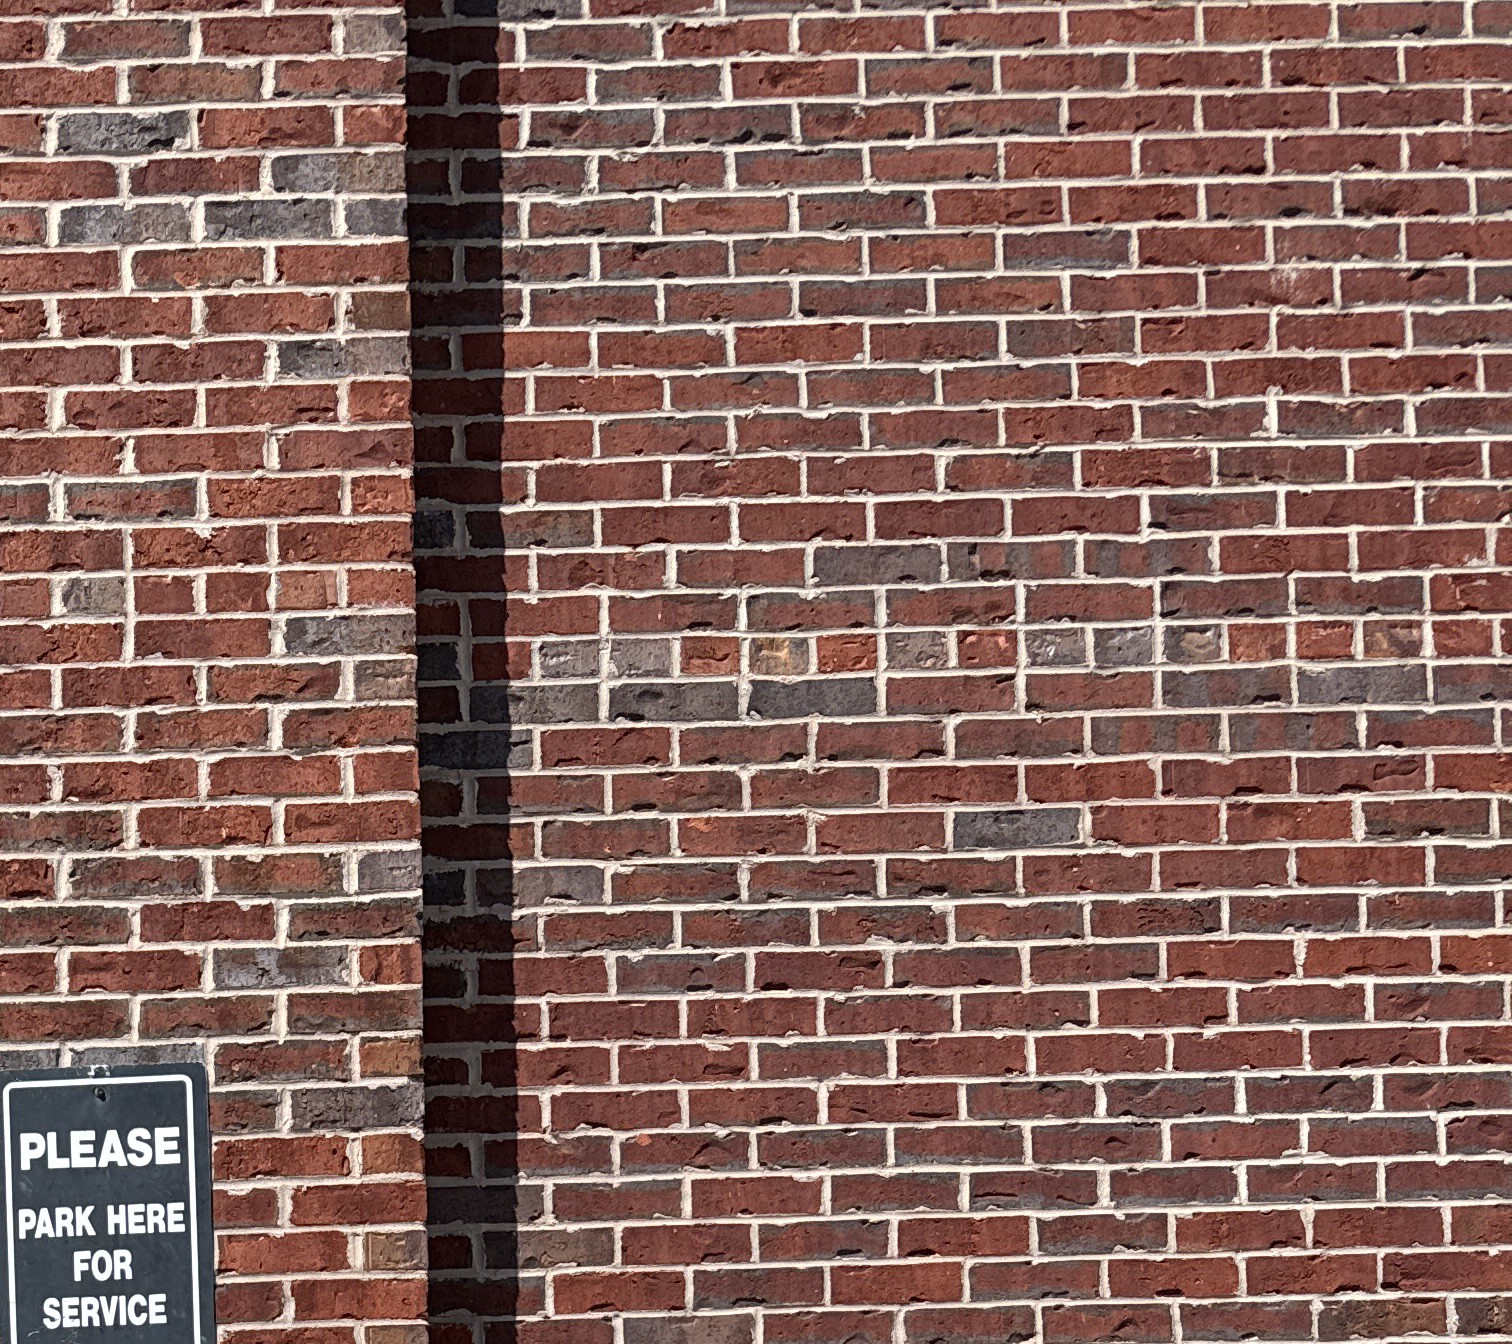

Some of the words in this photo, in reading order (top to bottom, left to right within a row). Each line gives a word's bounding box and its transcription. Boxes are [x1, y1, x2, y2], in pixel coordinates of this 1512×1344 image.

[19, 1126, 181, 1170] PLEASE
[18, 1205, 96, 1239] PARK
[107, 1202, 186, 1235] HERE
[73, 1249, 133, 1281] FOR
[42, 1293, 167, 1329] SERVICE
